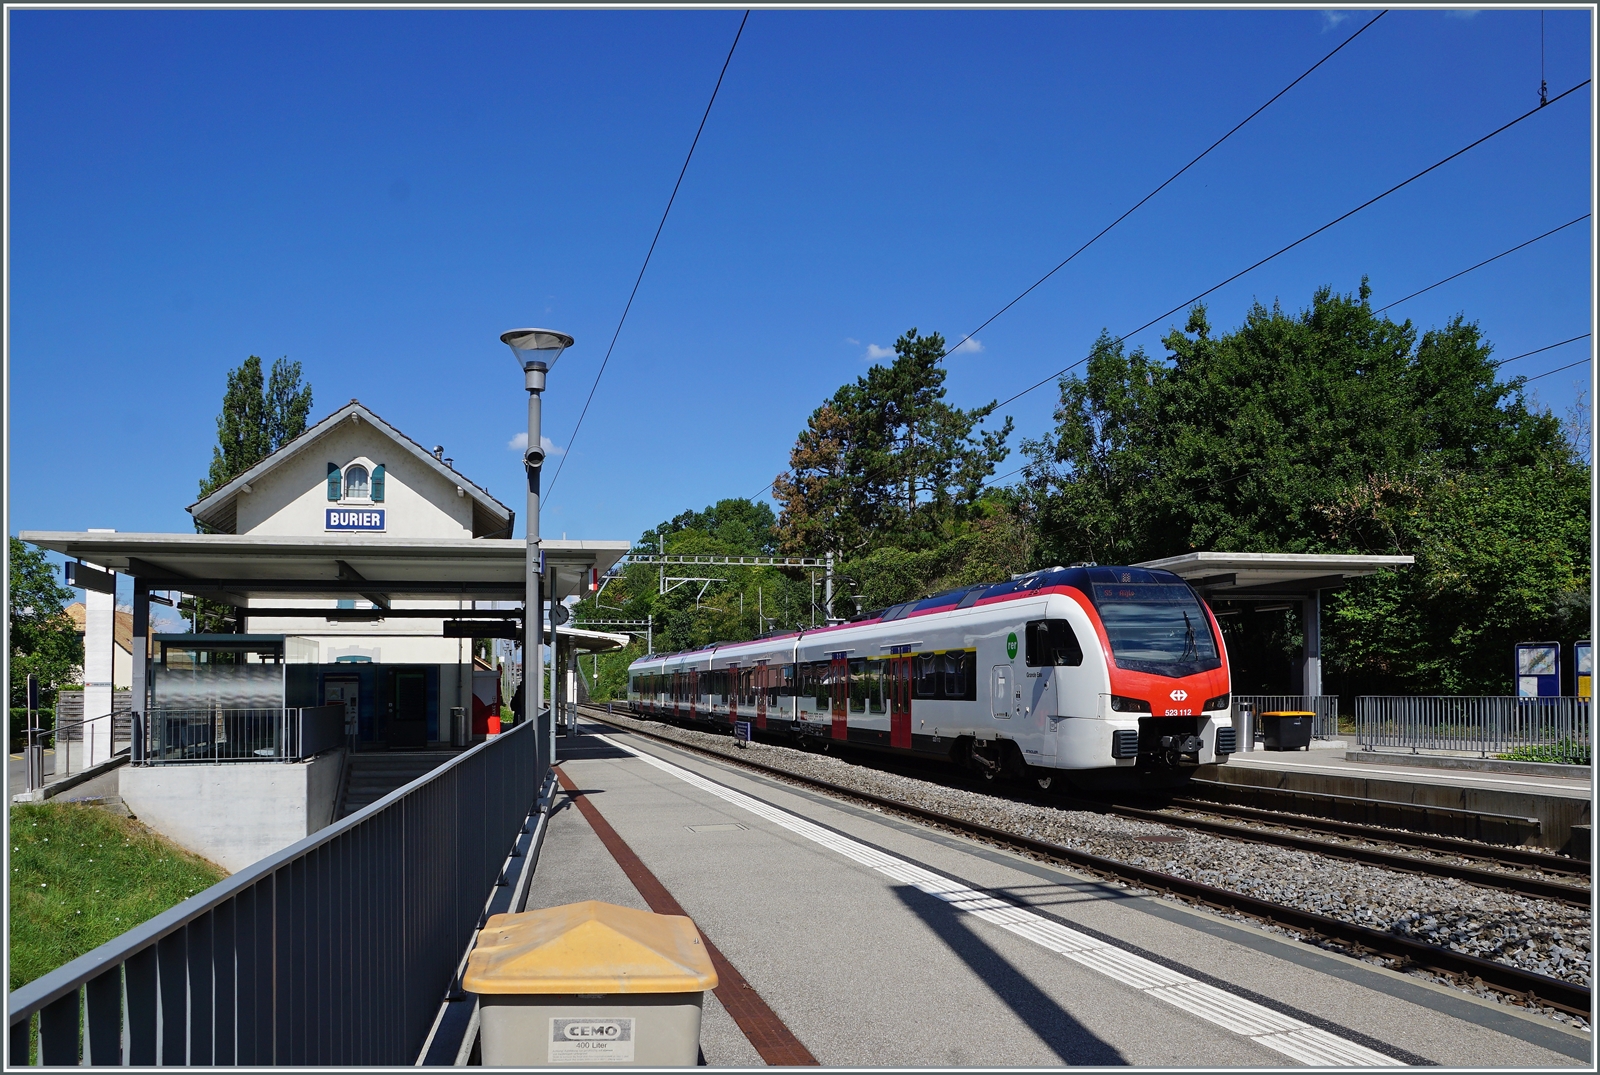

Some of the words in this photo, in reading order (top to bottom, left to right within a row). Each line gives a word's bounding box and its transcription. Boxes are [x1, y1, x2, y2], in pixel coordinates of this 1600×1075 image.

[330, 512, 380, 526] BURIER
[1119, 589, 1135, 598] Aigle
[1007, 641, 1017, 650] rer
[1179, 708, 1192, 716] 112
[569, 1026, 618, 1036] CEMO
